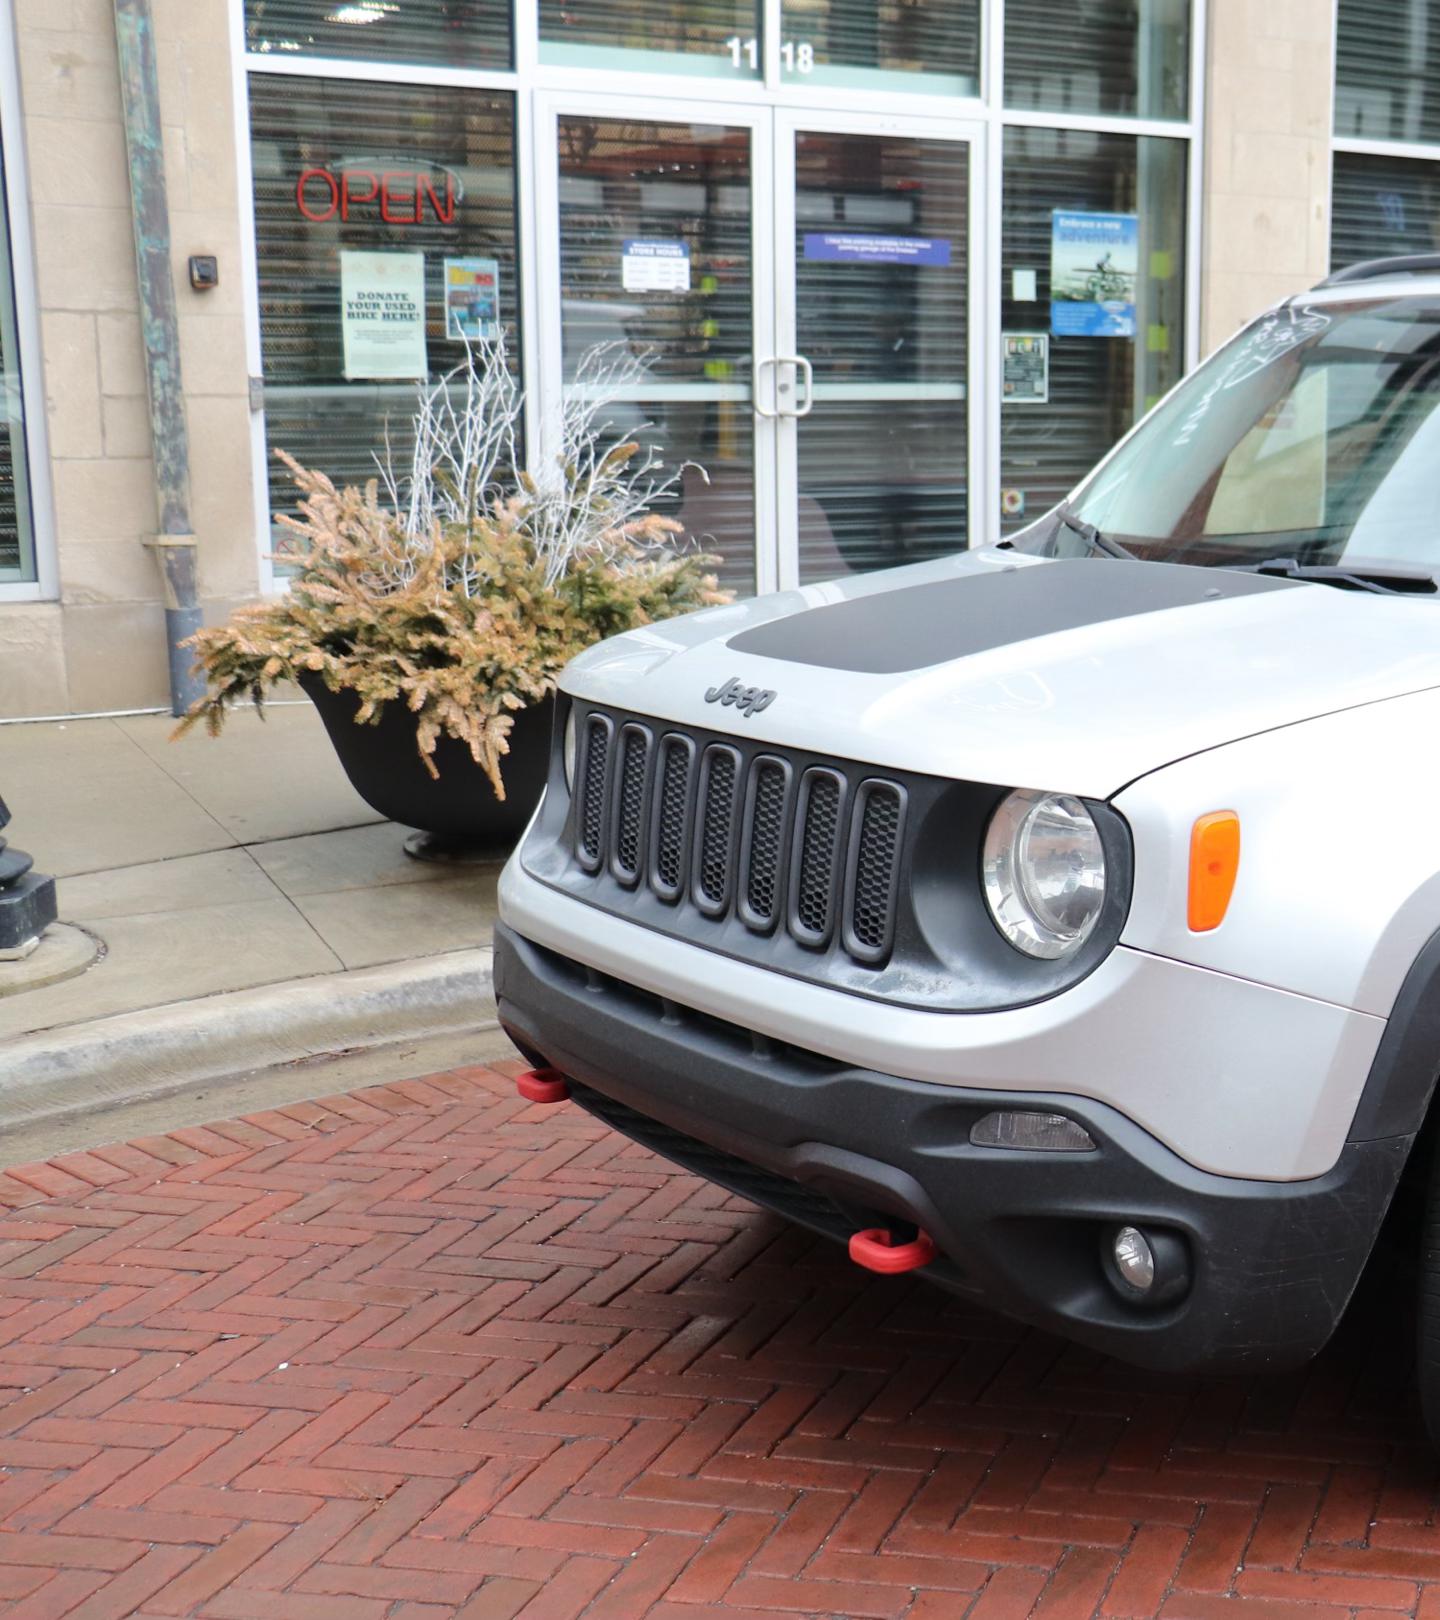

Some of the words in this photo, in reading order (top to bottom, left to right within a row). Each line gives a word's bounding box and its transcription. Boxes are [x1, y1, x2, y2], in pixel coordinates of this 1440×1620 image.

[297, 168, 455, 224] OPEN
[1059, 230, 1130, 245] adventure
[357, 291, 409, 301] DONATE
[347, 301, 381, 310] YOUR
[385, 302, 416, 311] USED
[347, 311, 378, 320] BIKE
[704, 677, 778, 718] Jeep
